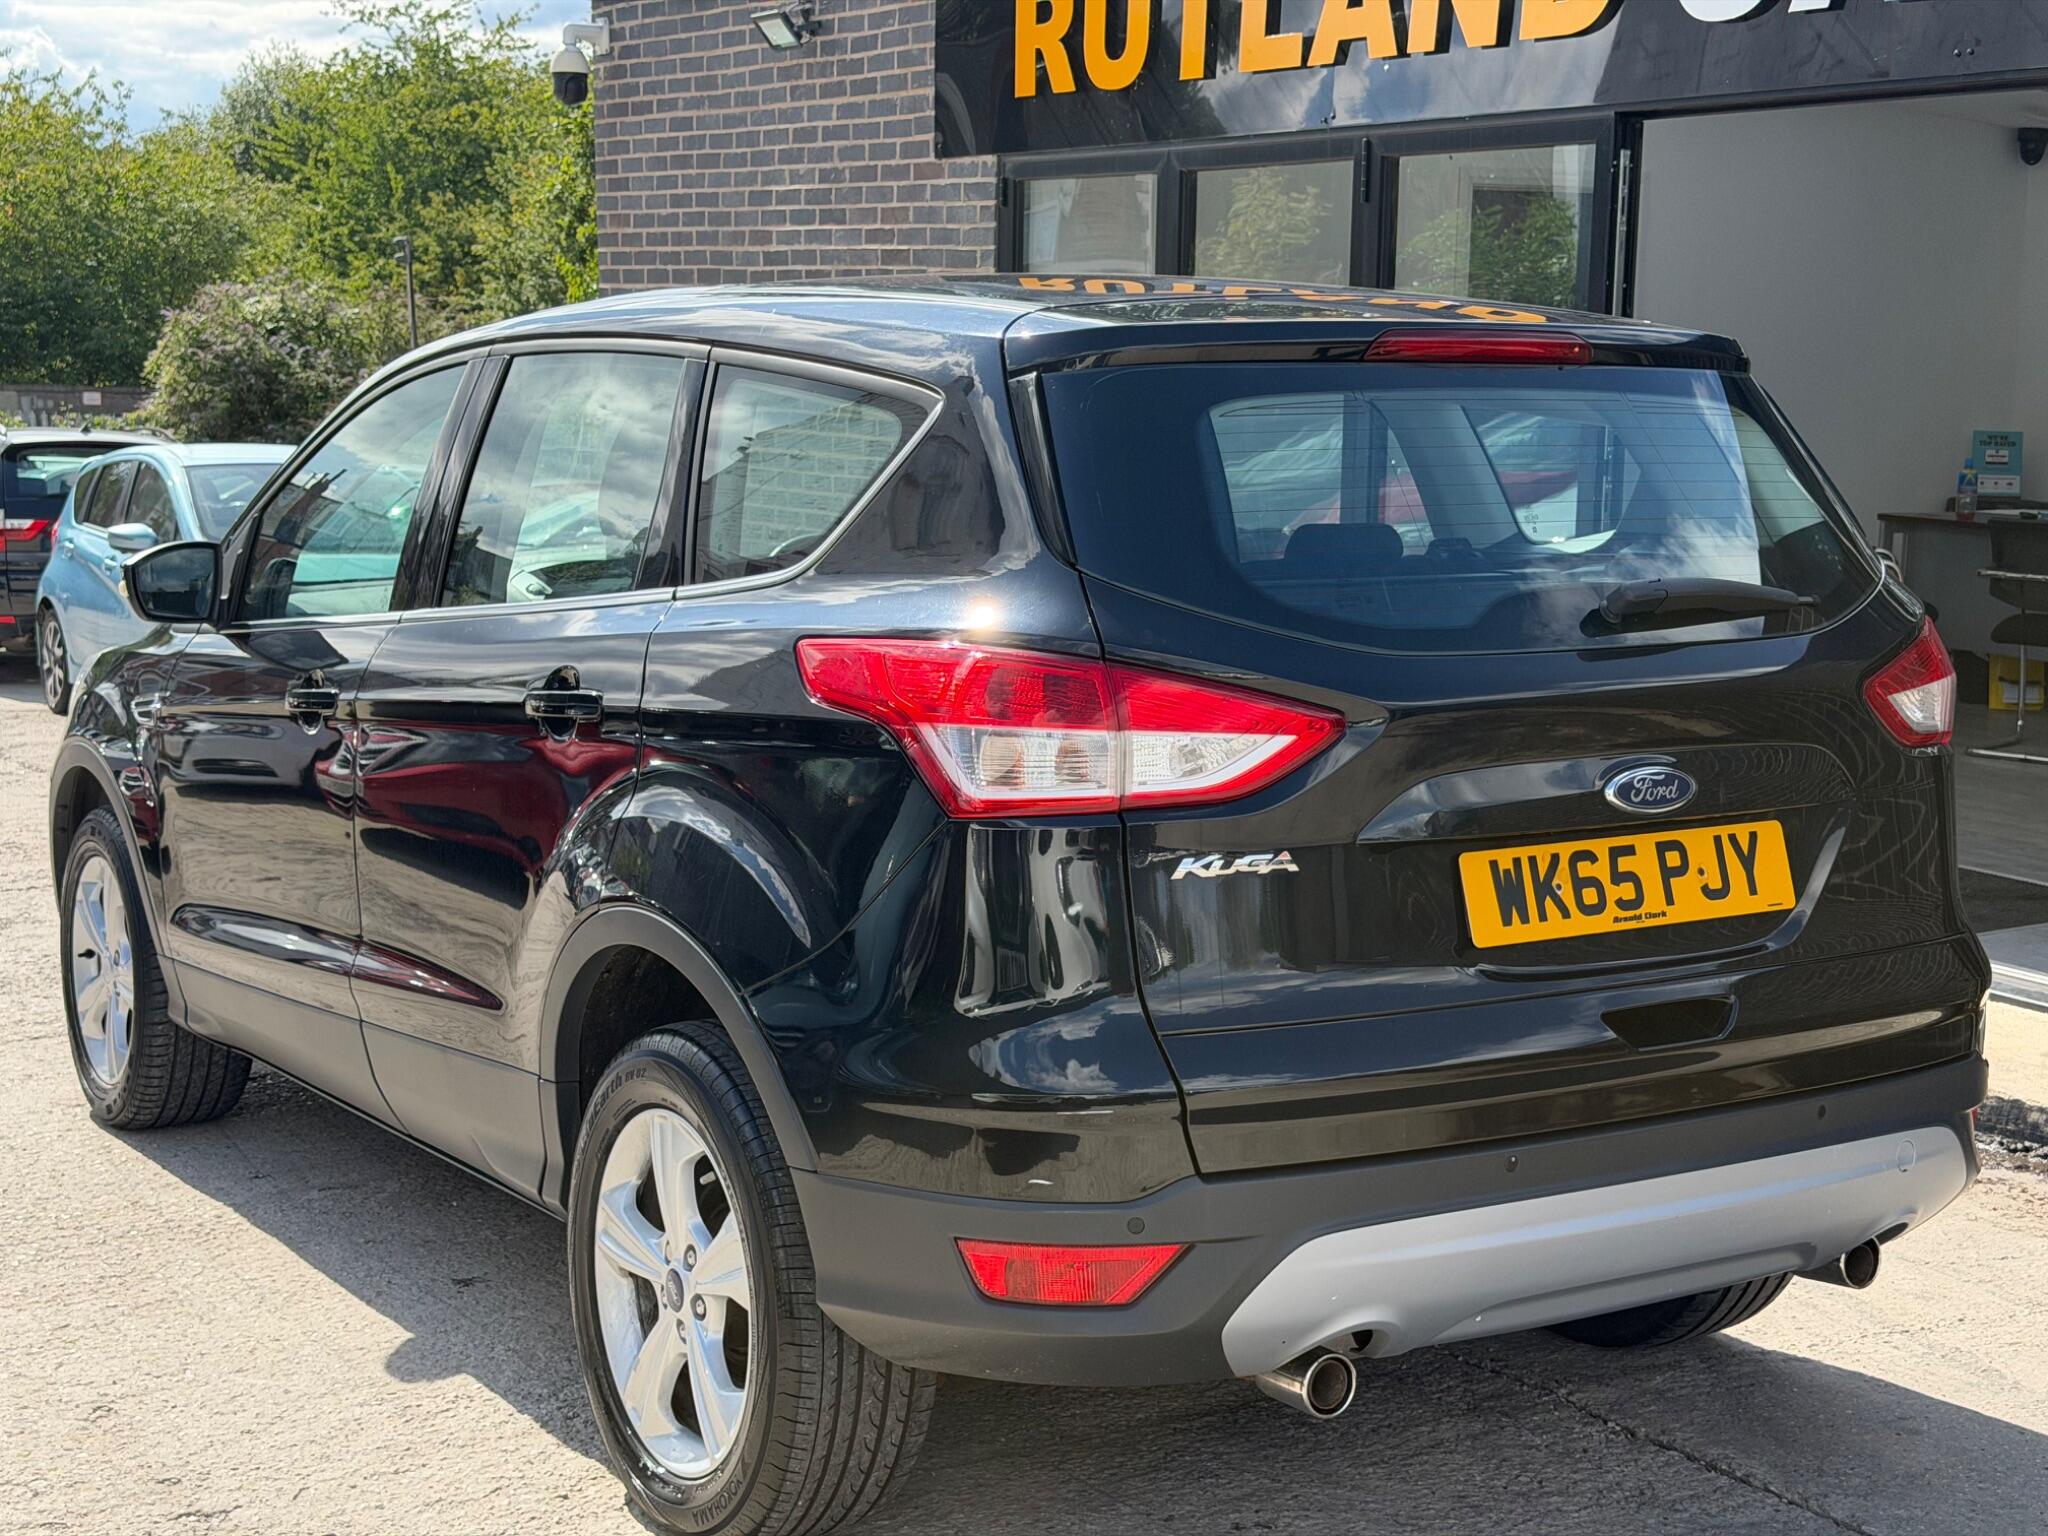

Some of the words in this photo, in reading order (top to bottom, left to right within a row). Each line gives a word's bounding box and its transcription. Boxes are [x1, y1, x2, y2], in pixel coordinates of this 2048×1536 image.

[1630, 773, 1679, 802] Ford
[1170, 850, 1300, 880] KUGA
[1488, 843, 1645, 927] WK65
[1655, 830, 1759, 906] PJY
